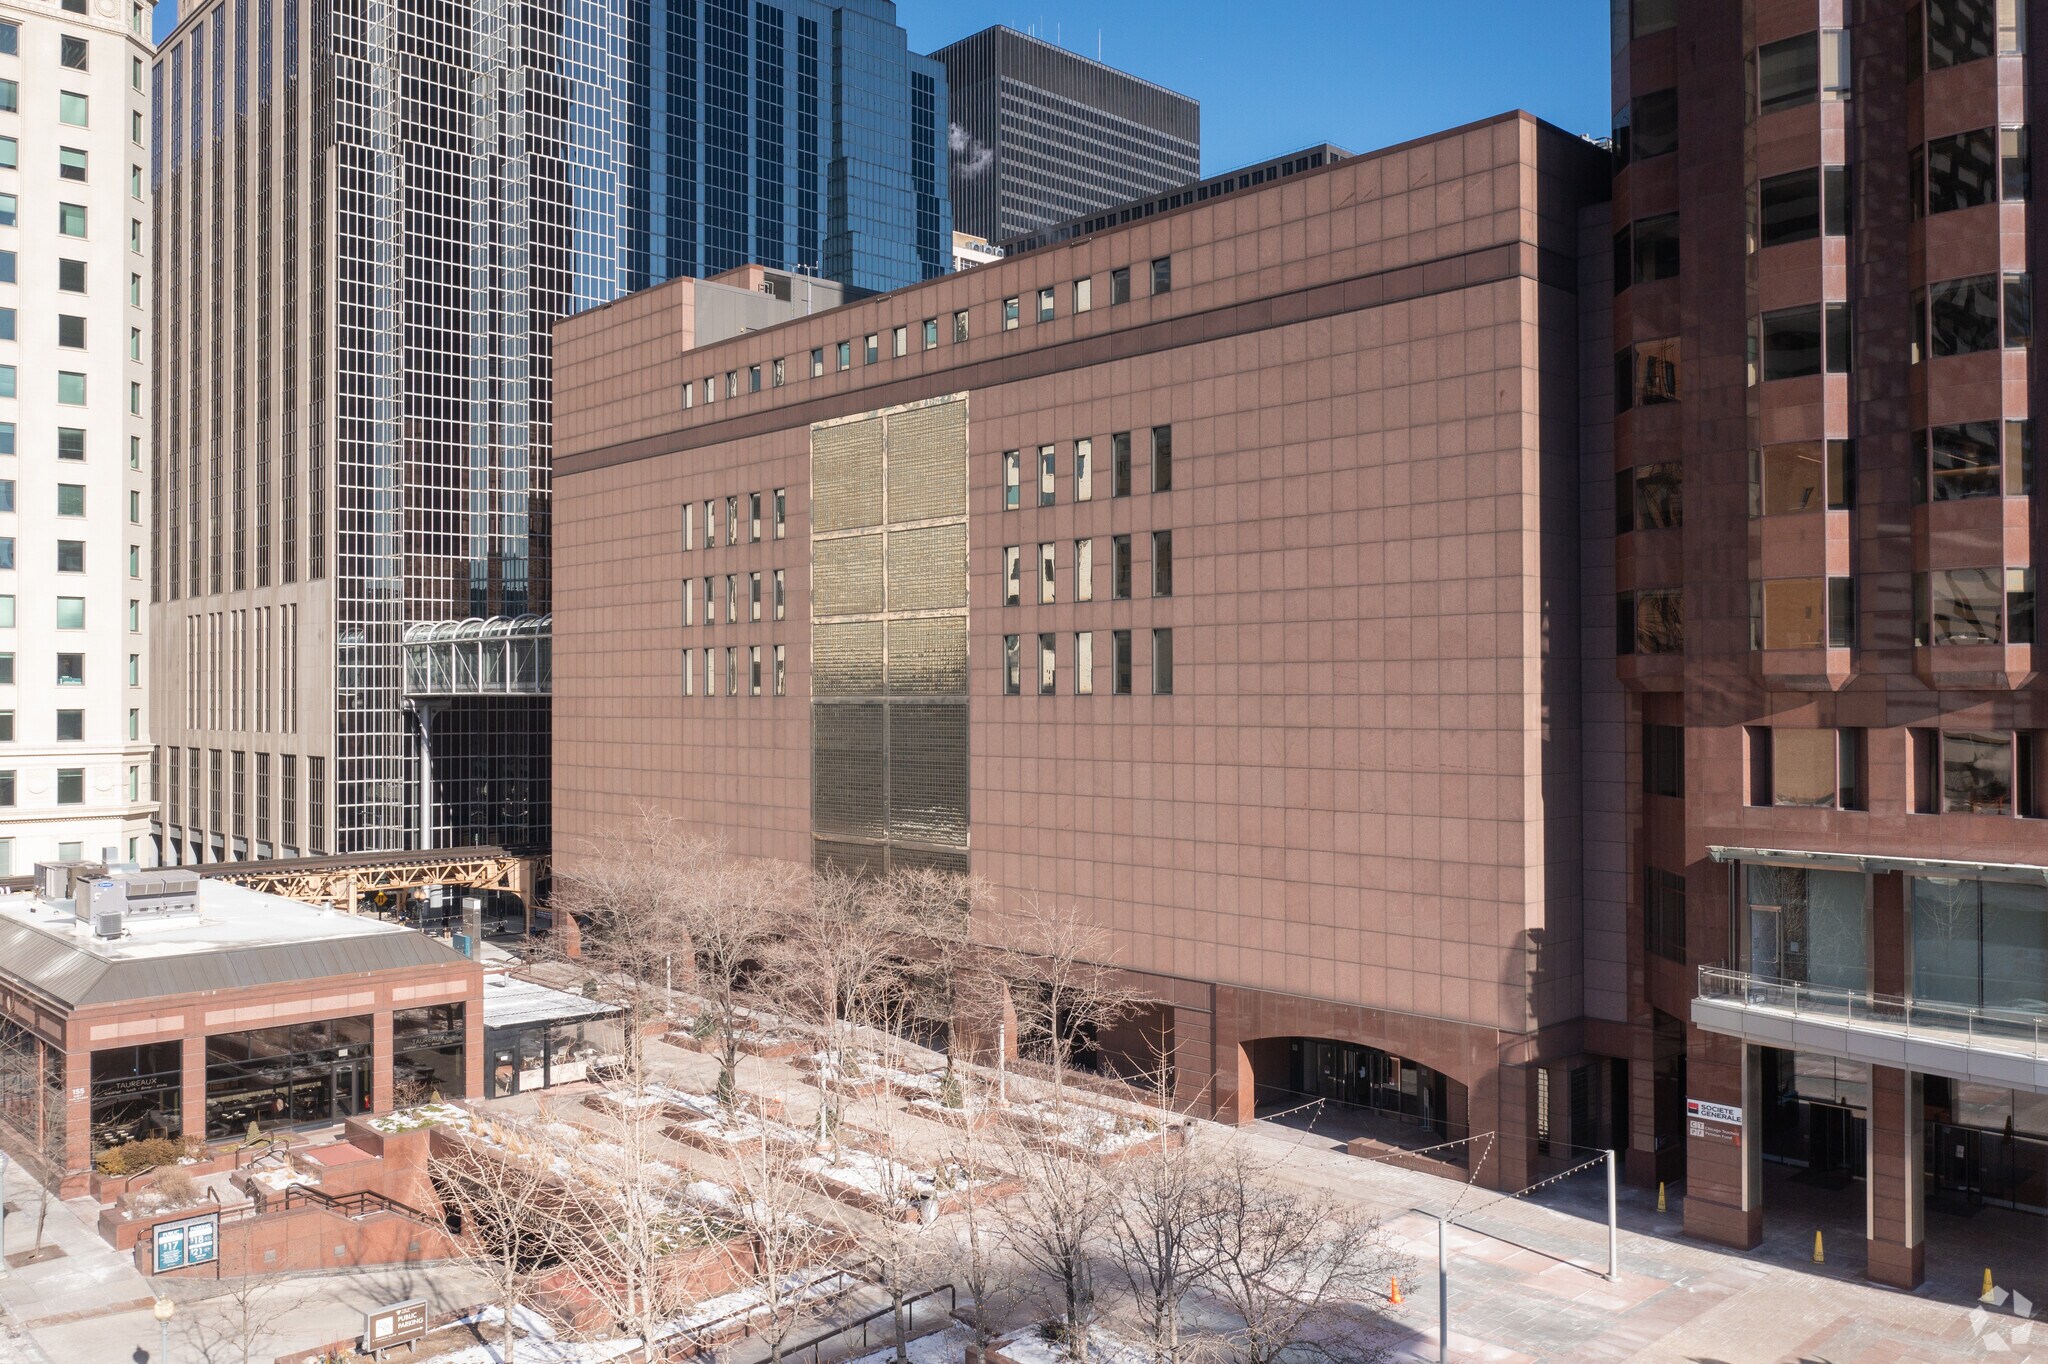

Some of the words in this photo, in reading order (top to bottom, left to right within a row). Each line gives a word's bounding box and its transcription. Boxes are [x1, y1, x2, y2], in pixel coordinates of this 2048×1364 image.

[116, 1078, 157, 1089] TAUREAUX
[1700, 1104, 1734, 1115] SOCIETE
[1700, 1110, 1742, 1122] GENERALE
[163, 1241, 179, 1250] $17
[398, 1312, 417, 1322] PUBLIC
[398, 1317, 423, 1329] PARKING
